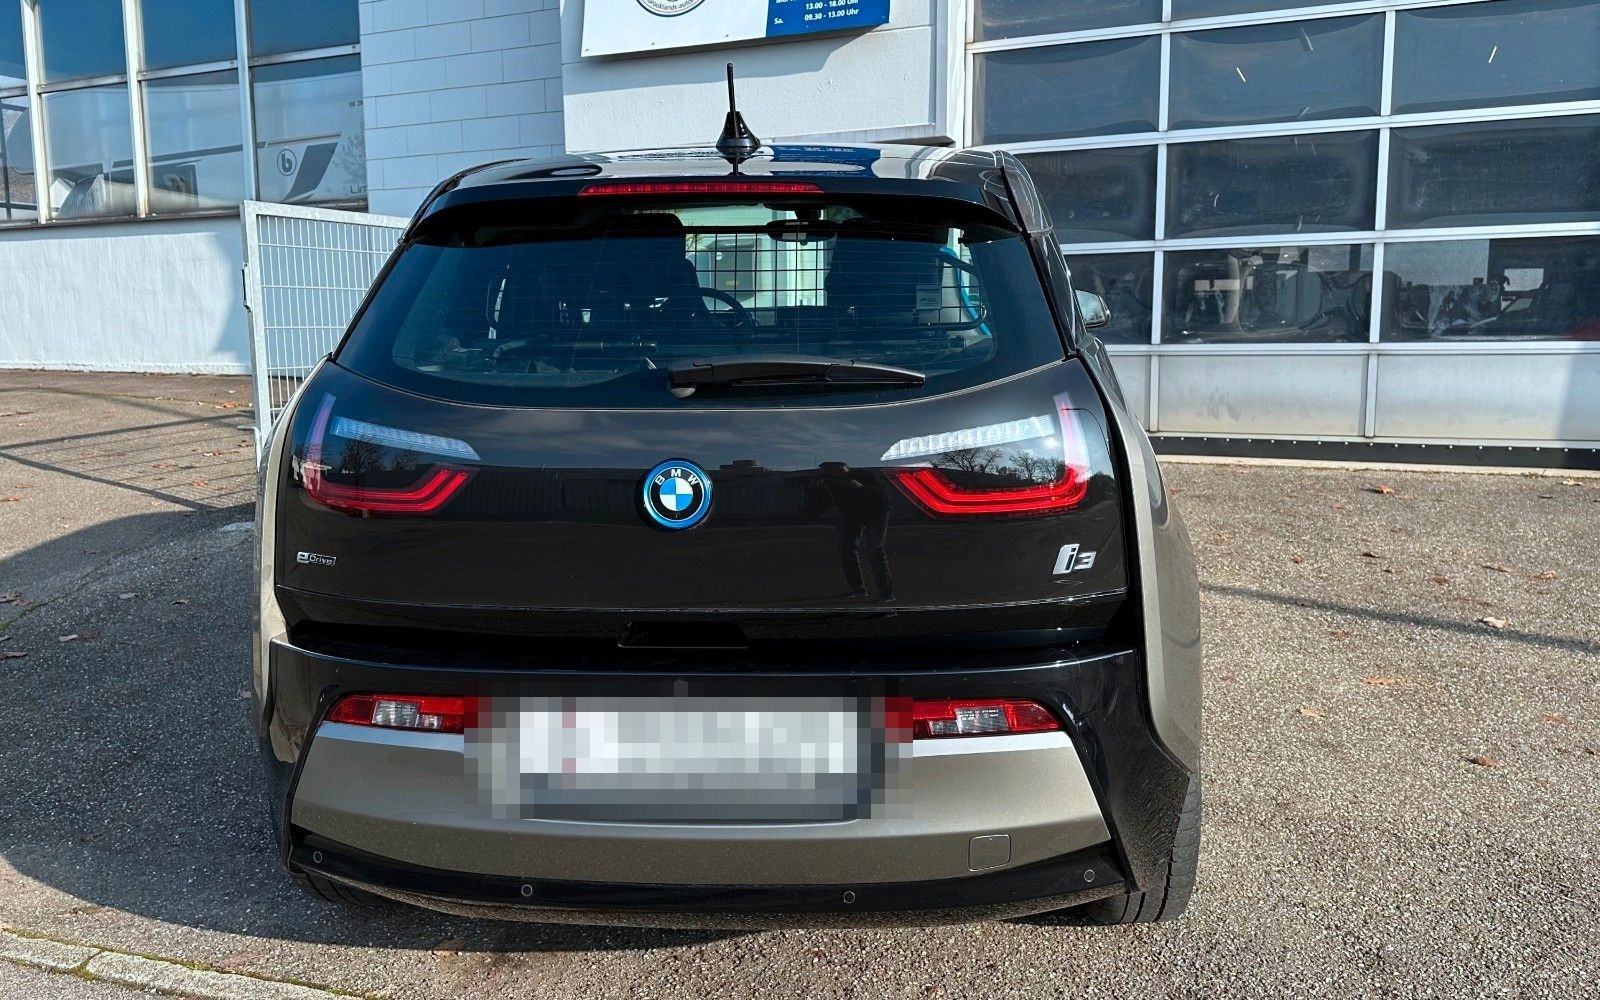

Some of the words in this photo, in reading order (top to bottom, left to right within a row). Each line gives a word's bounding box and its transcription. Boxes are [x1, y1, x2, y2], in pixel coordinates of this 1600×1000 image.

[805, 2, 823, 10] 13.00
[804, 12, 823, 21] 09.30
[828, 10, 845, 18] 13.00
[846, 8, 860, 16] Uhr
[654, 468, 699, 486] BMW
[1052, 543, 1097, 575] i3
